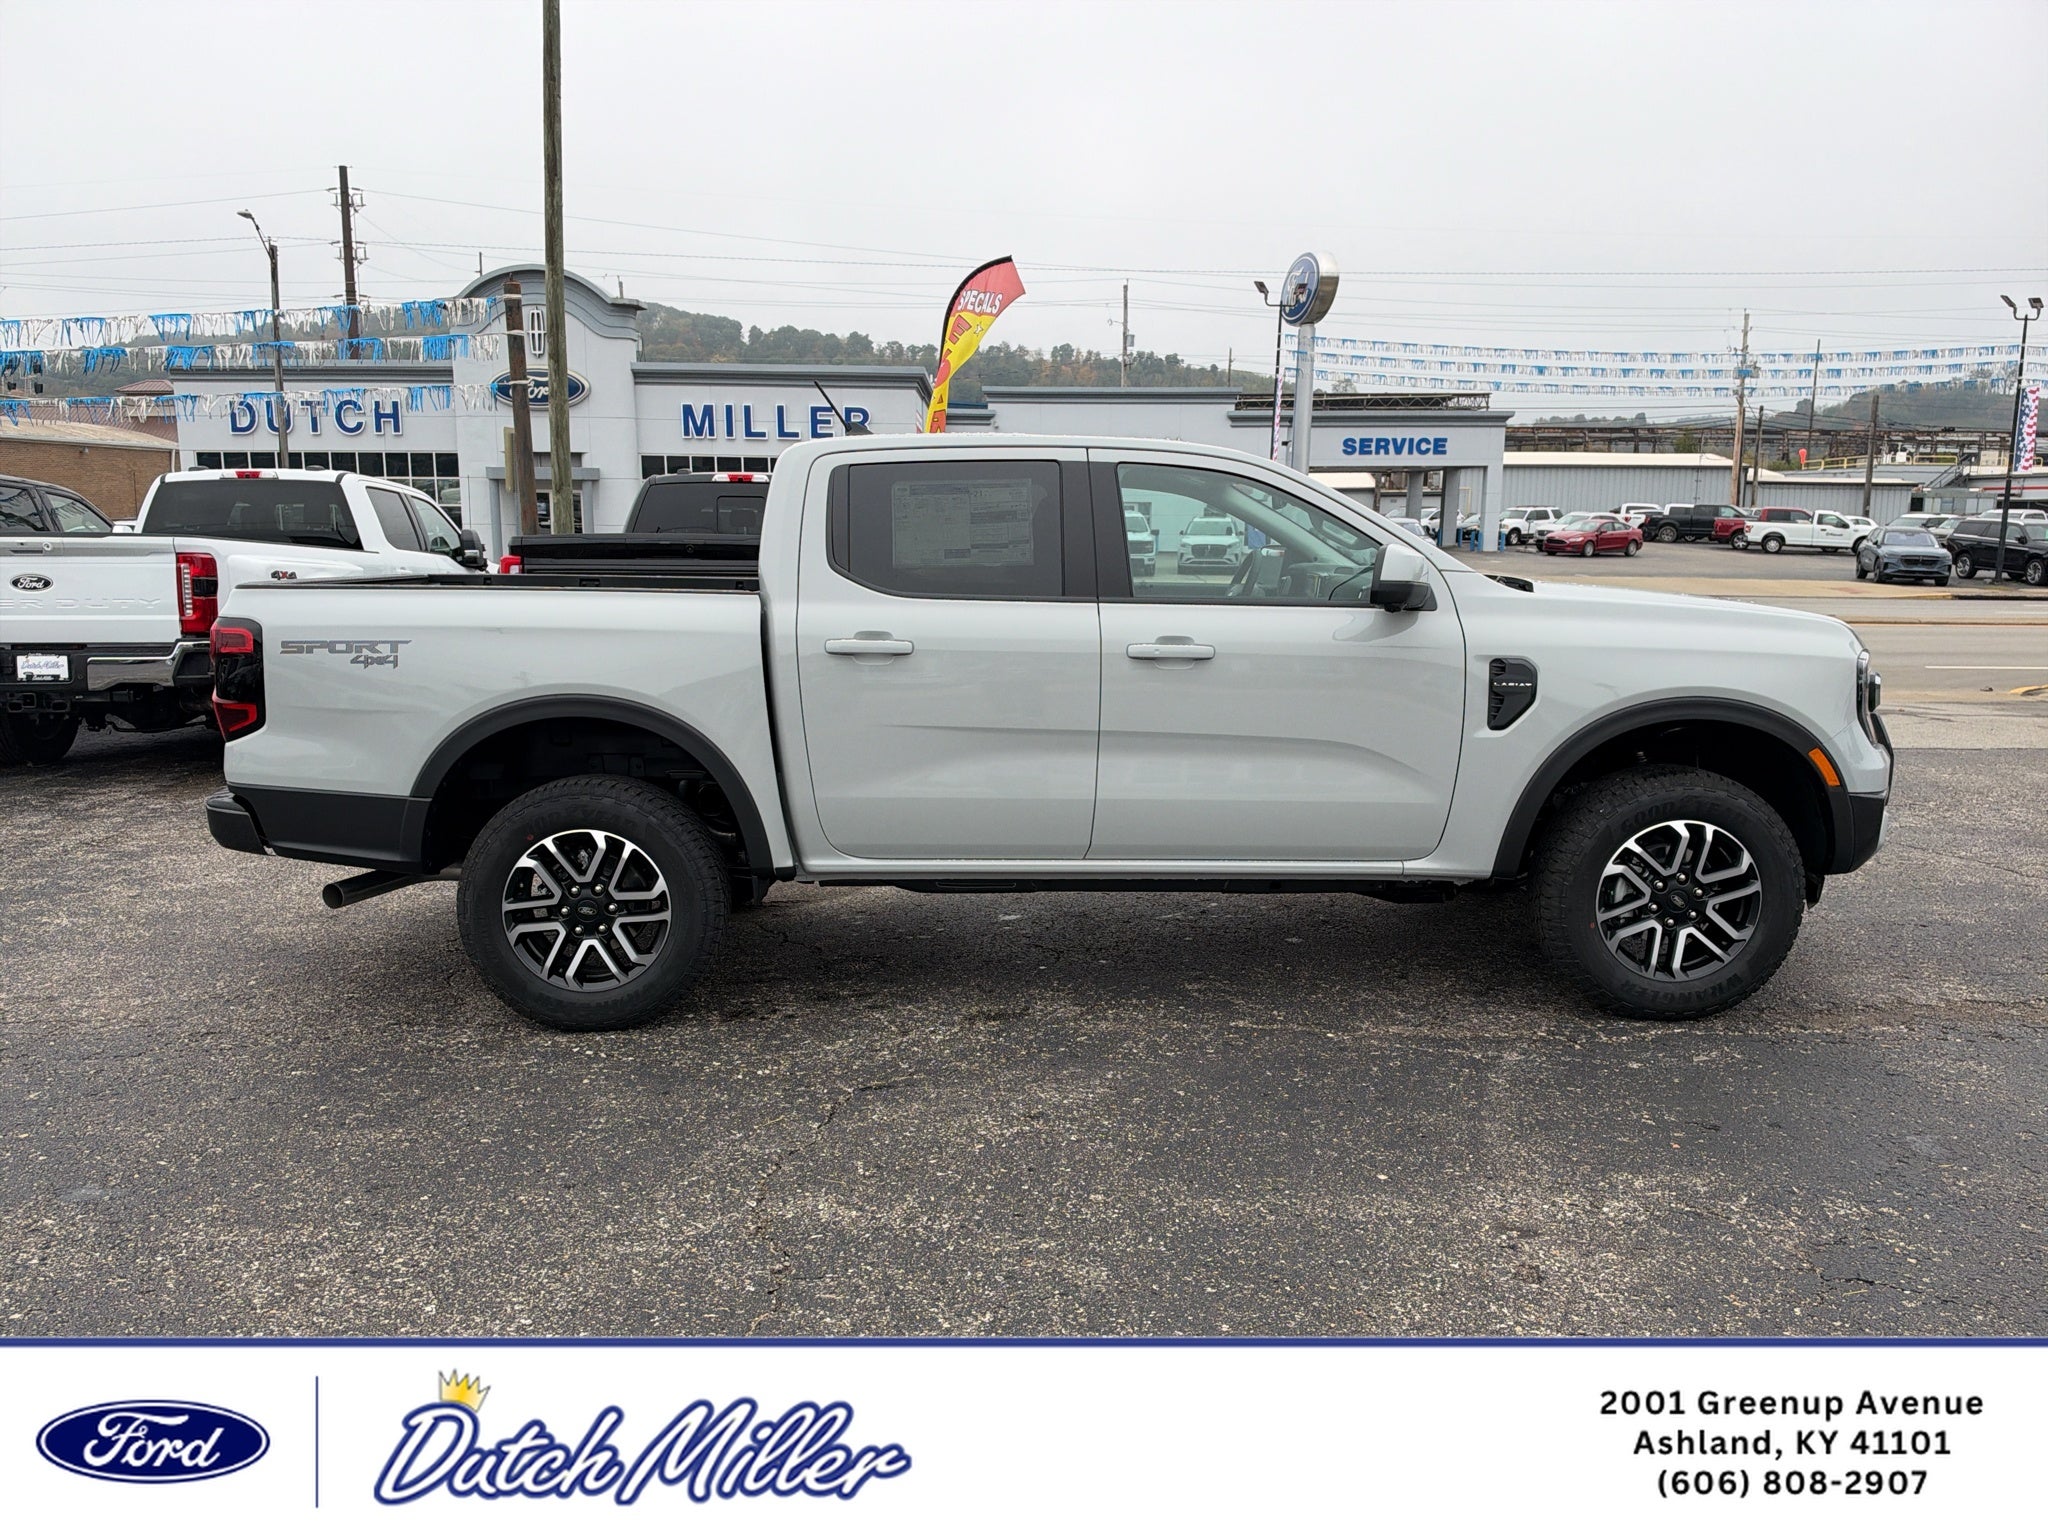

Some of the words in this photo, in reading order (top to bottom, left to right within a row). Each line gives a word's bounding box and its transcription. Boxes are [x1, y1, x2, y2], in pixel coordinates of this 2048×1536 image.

[228, 399, 403, 436] DUTCH
[681, 402, 871, 440] MILLER
[1342, 437, 1448, 455] SERVICE
[17, 576, 45, 590] Ford
[55, 598, 161, 609] DUTY
[280, 640, 412, 654] SPORT
[350, 655, 398, 669] 4x4
